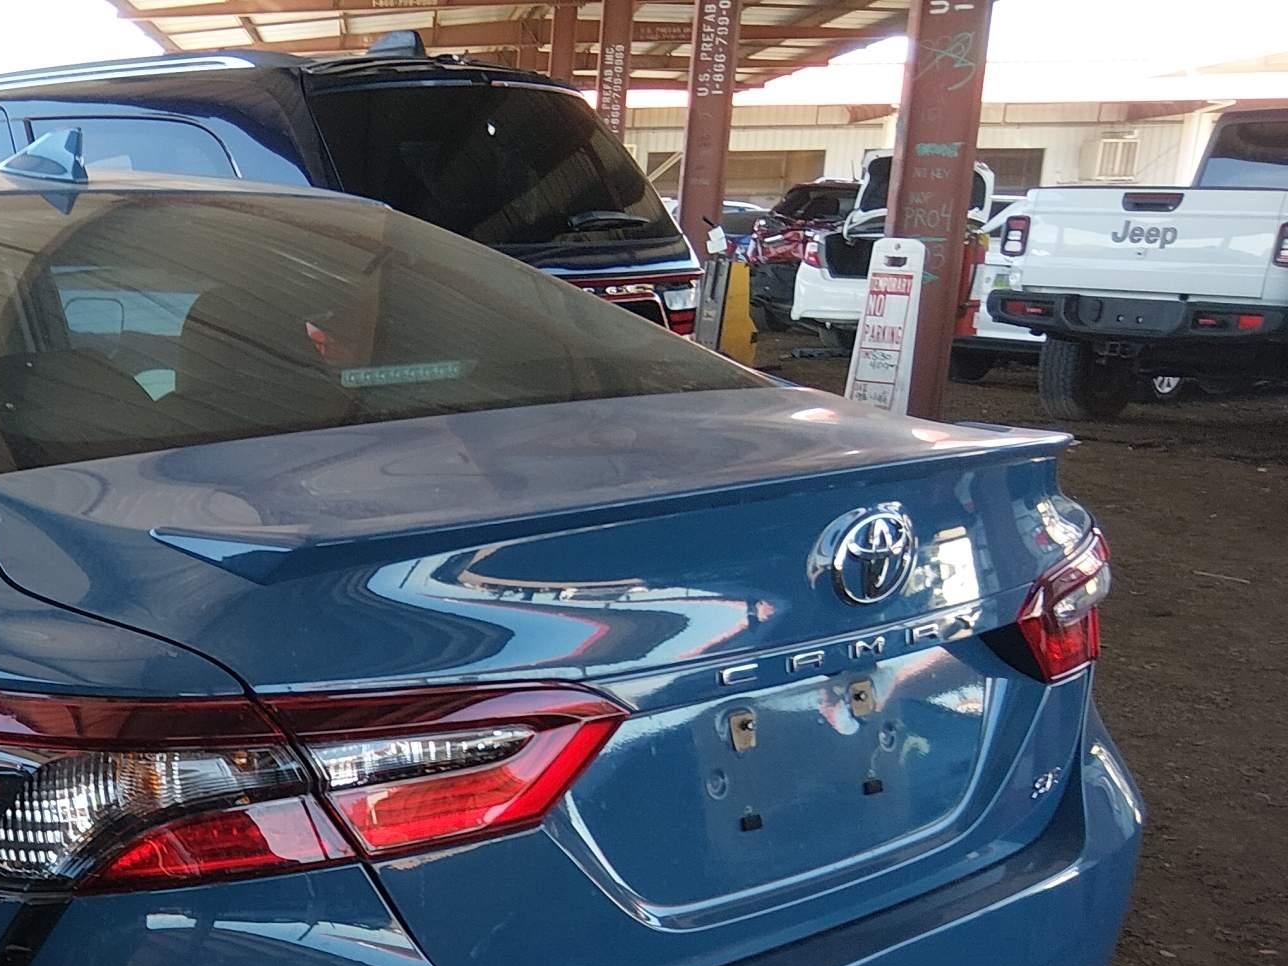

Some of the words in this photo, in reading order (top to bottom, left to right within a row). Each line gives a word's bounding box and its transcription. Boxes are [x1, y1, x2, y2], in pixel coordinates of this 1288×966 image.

[700, 4, 717, 61] PREFAB
[1111, 219, 1178, 249] Jeep
[867, 294, 886, 317] NO
[864, 323, 902, 346] PARKING
[716, 608, 981, 687] CAMRY
